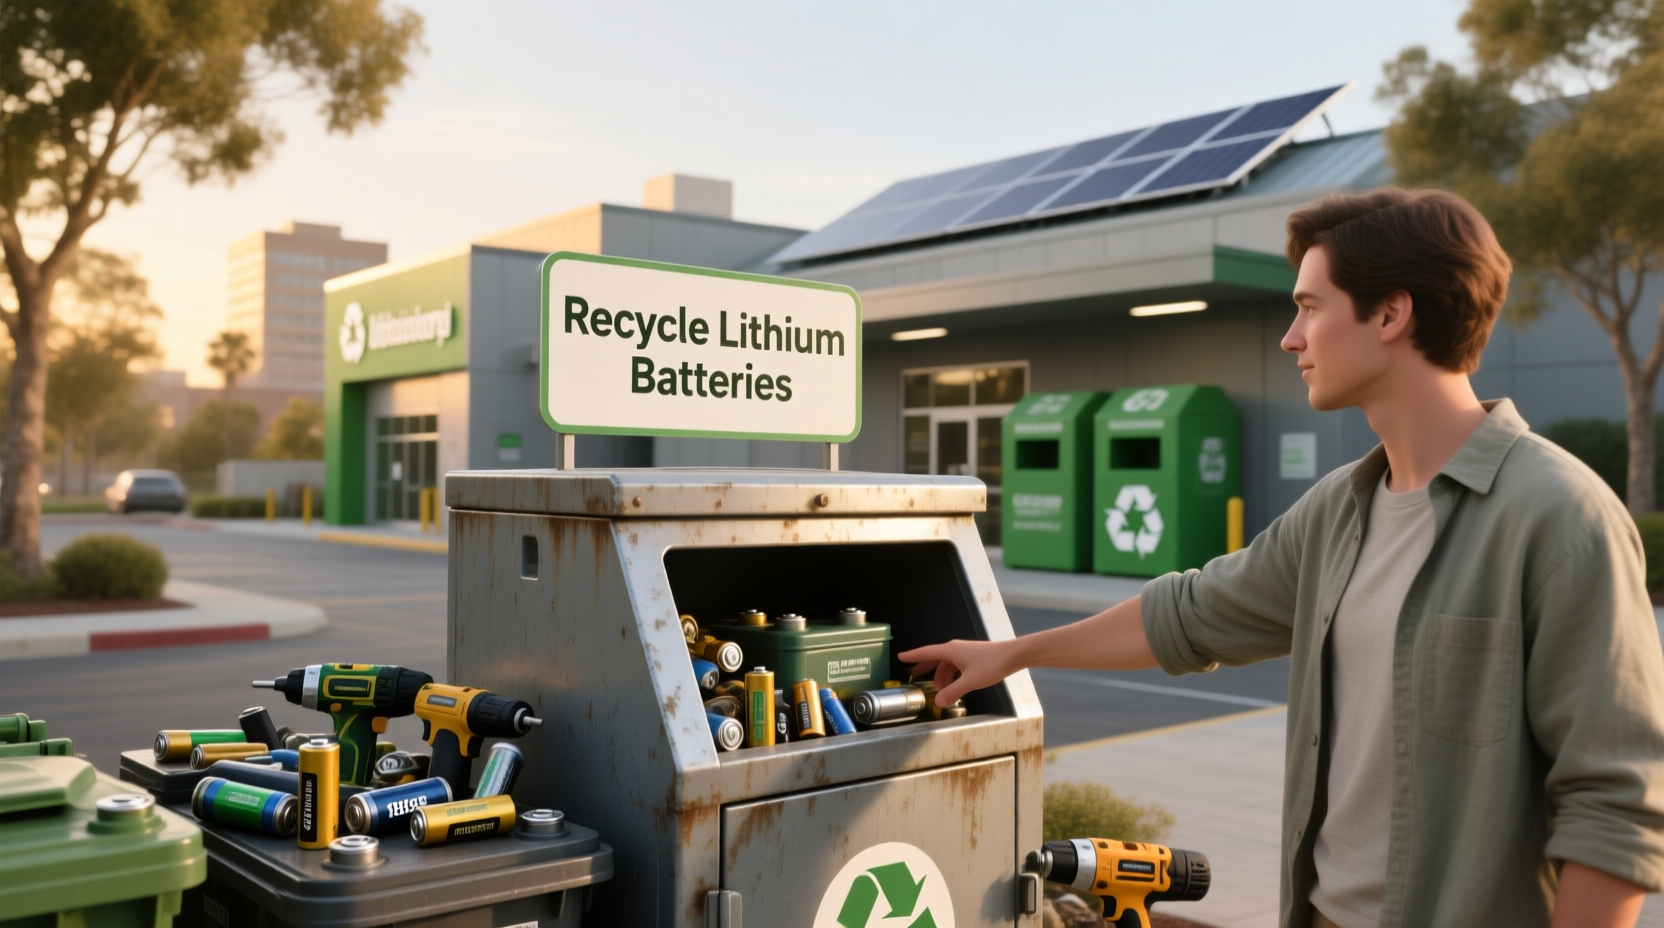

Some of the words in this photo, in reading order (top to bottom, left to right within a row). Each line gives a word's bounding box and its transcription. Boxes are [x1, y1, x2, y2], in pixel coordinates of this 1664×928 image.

[564, 295, 710, 350] Recycle
[719, 310, 845, 357] Lithium
[631, 355, 793, 402] Batteries
